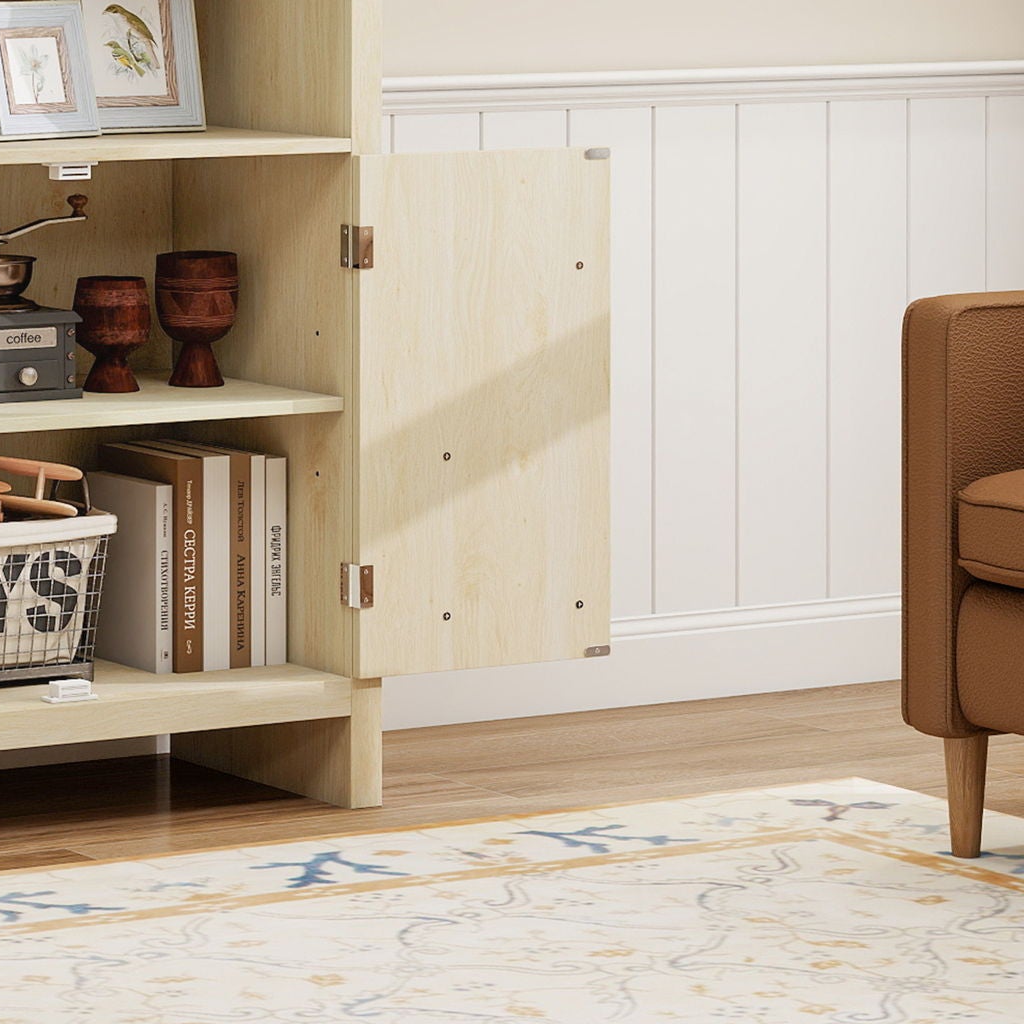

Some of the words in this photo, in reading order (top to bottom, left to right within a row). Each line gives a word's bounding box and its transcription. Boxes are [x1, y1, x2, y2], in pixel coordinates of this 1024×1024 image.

[6, 332, 42, 345] coffee
[183, 529, 196, 582] СЕСТРА
[270, 525, 282, 561] ФРИДРИХ
[160, 550, 169, 631] СТИХОТВОРЕНИЯ
[270, 564, 281, 597] ЭНГЕЛЬС
[183, 586, 196, 630] КЕРРИ
